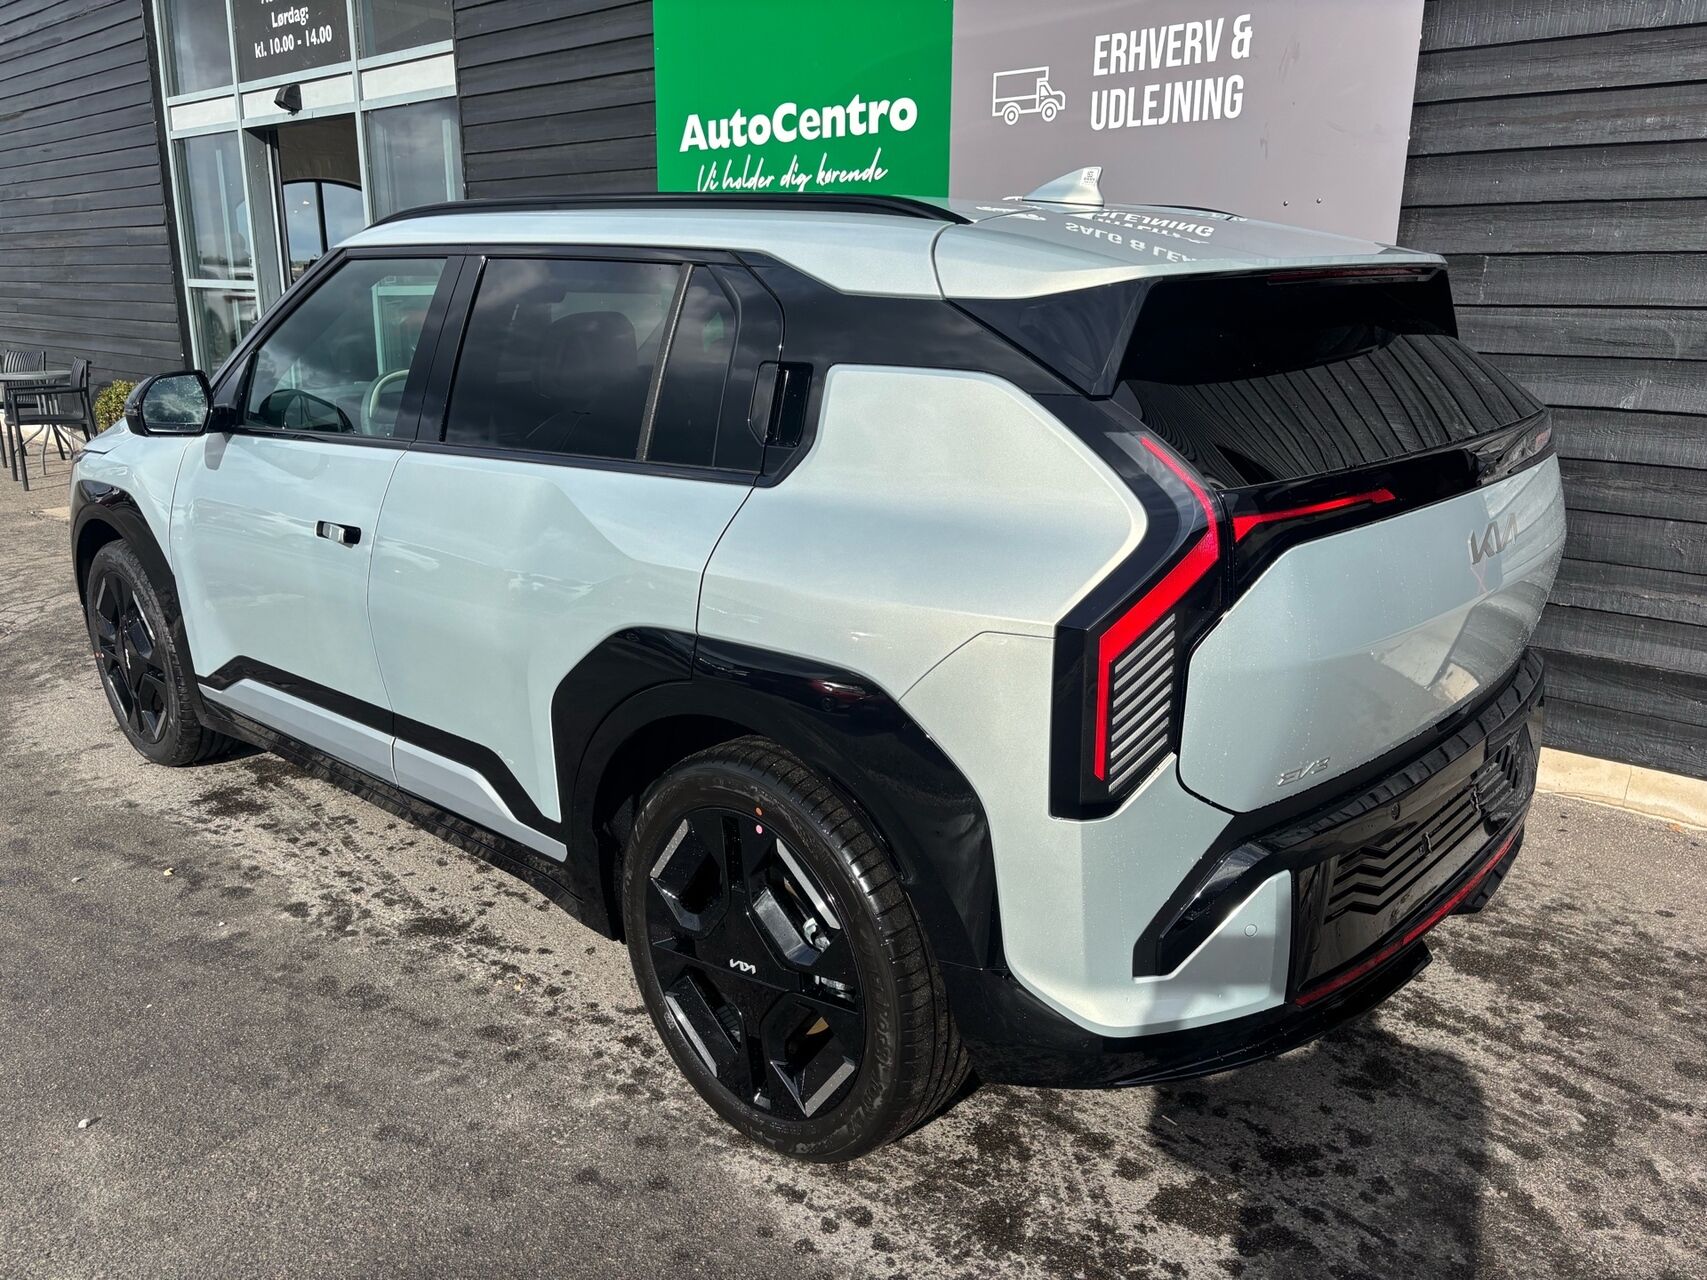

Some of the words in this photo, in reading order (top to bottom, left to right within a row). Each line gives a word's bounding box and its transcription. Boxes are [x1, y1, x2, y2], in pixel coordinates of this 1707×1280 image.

[254, 42, 267, 58] kl.
[270, 34, 295, 55] 10.00
[305, 25, 333, 47] 14.00
[271, 6, 309, 28] Lørdag:
[1093, 18, 1225, 77] ERHVERV
[1231, 14, 1253, 59] &
[679, 94, 918, 153] AutoCentro
[1090, 74, 1244, 132] UDLEJNING
[697, 161, 719, 192] Vi
[722, 154, 775, 191] holder
[780, 154, 813, 192] dig
[816, 146, 889, 186] kørende
[1468, 513, 1518, 565] KIA
[1278, 757, 1330, 787] EV3
